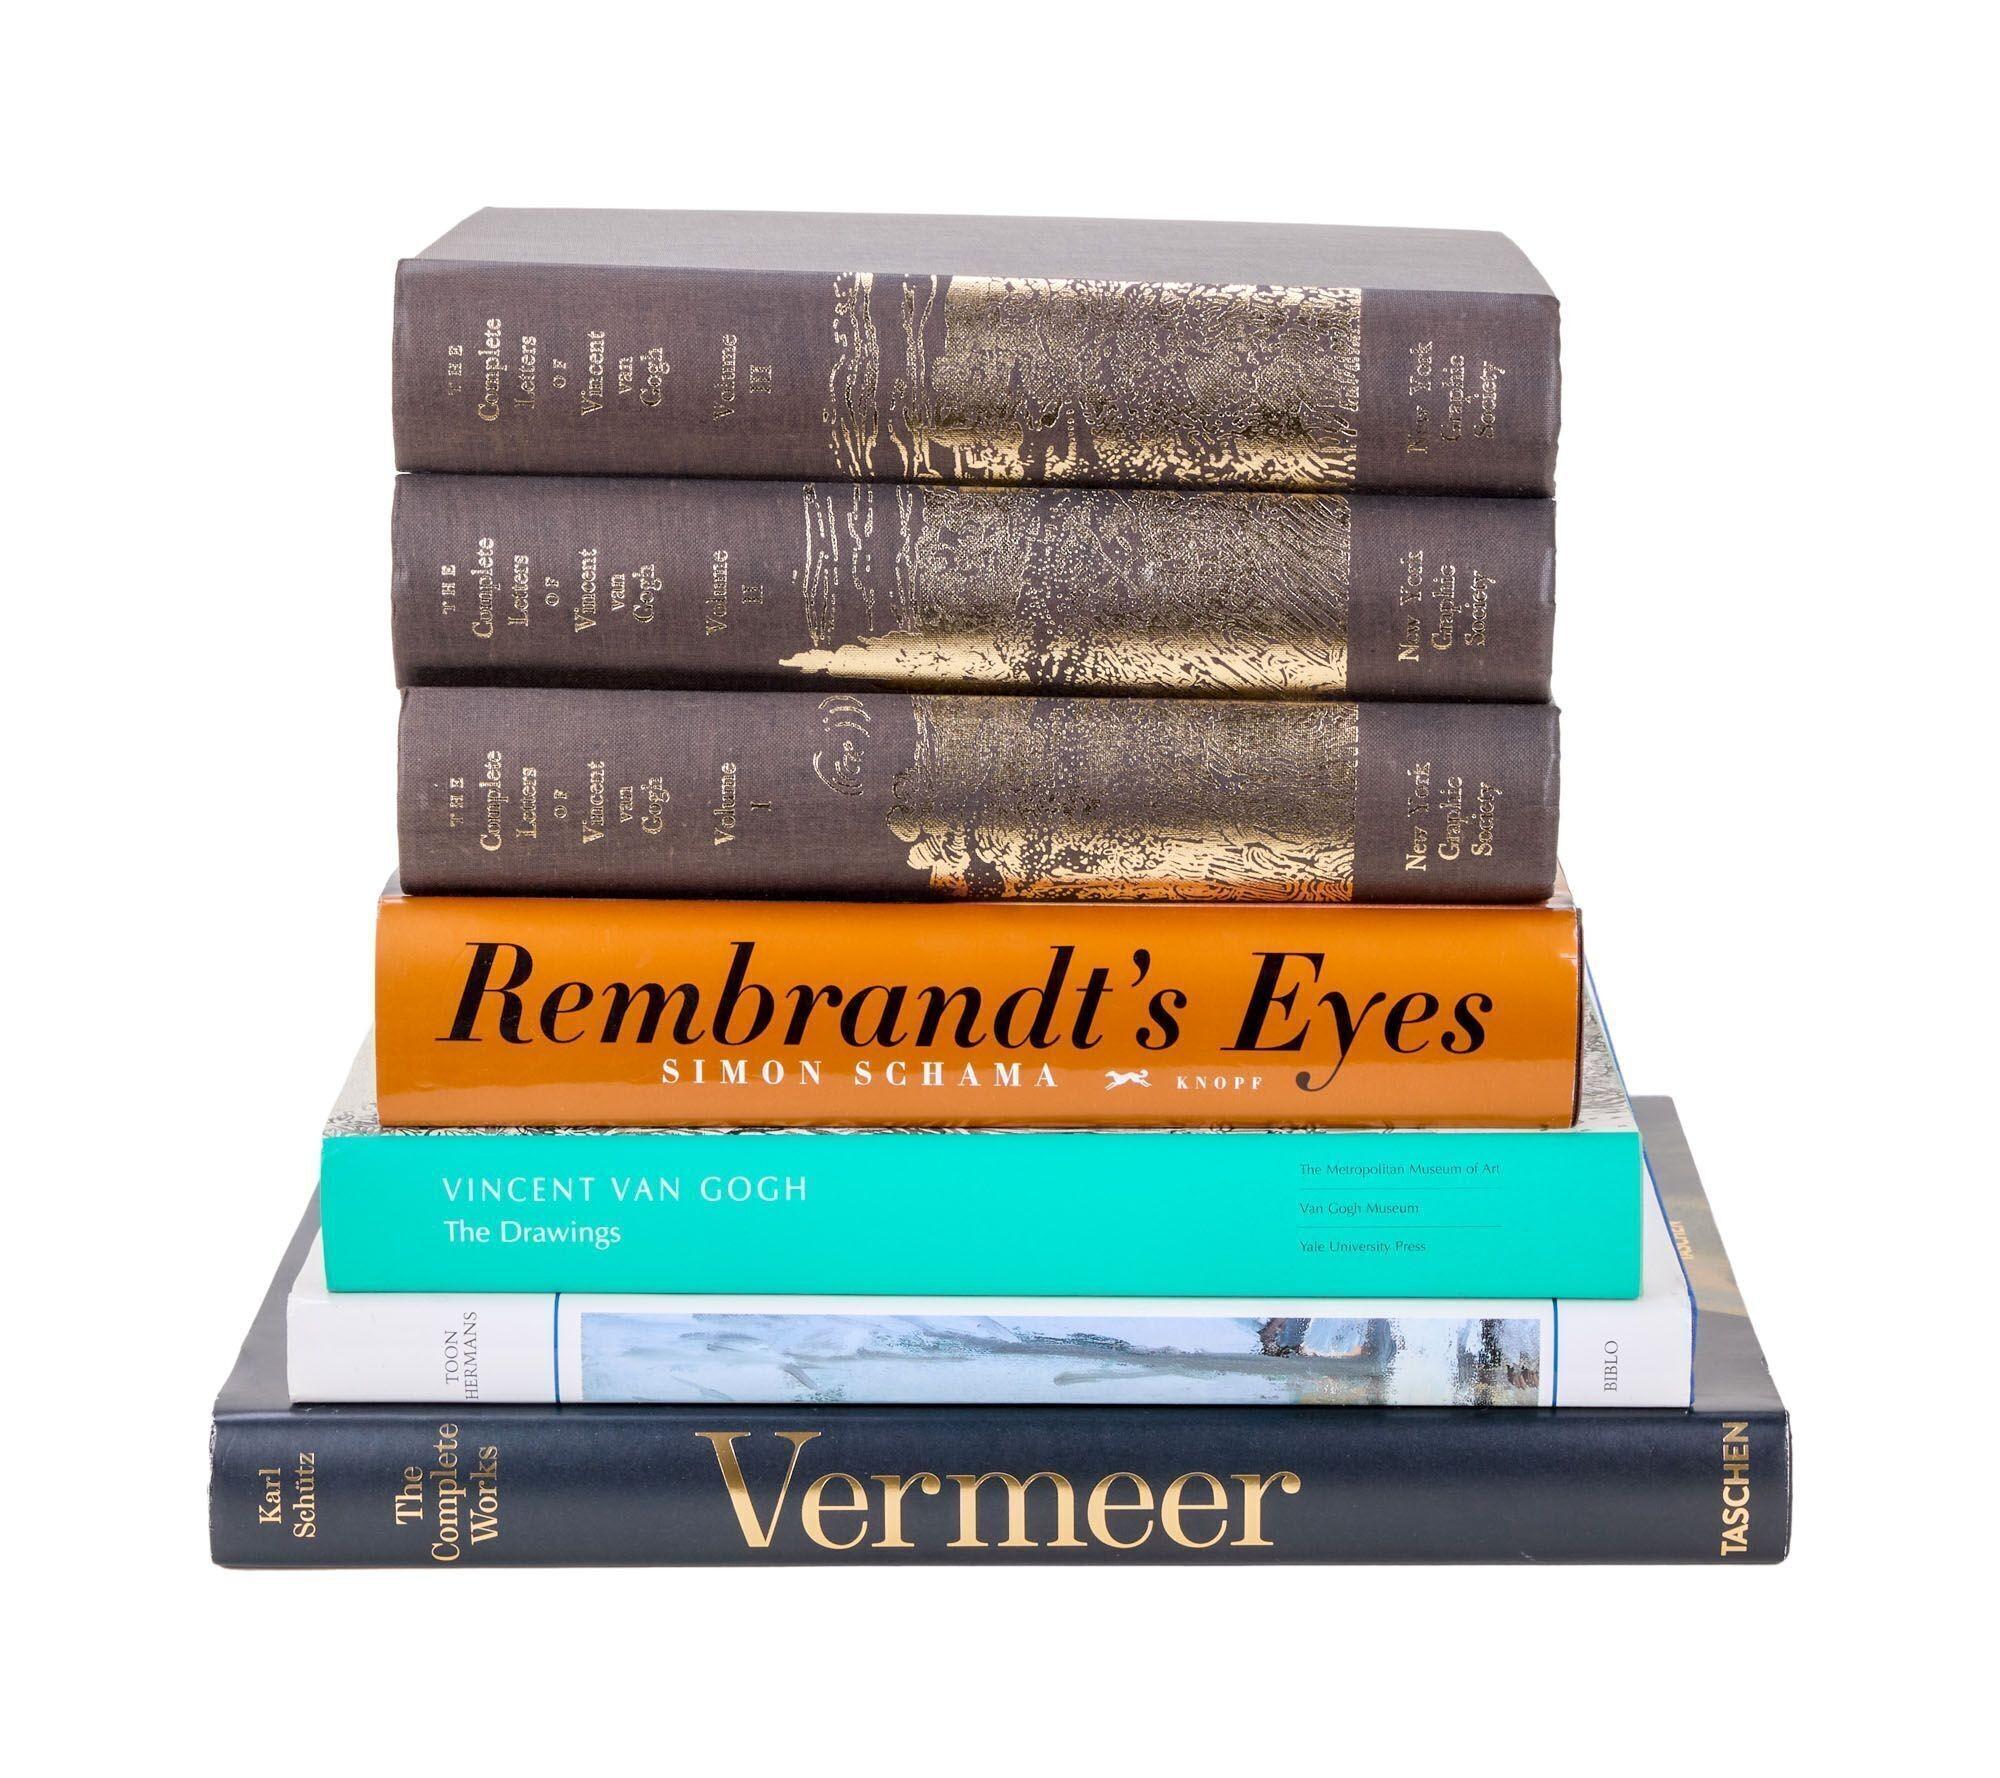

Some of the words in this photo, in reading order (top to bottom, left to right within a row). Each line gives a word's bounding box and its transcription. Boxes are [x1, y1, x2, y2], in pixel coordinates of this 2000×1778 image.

[448, 344, 463, 396] THE
[478, 318, 507, 421] Complete
[514, 335, 537, 409] Letters
[552, 359, 567, 389] OF
[581, 330, 606, 416] Vincent
[618, 356, 633, 394] van
[640, 346, 670, 407] Gogh
[713, 334, 737, 421] Volume
[1409, 341, 1432, 396] York
[1440, 355, 1471, 441] Graphic
[1473, 360, 1506, 438] Society
[1406, 405, 1429, 454] New
[442, 564, 456, 614] THE
[472, 537, 500, 639] Complete
[508, 554, 529, 627] Letters
[545, 577, 559, 606] OF
[574, 548, 597, 632] Vincent
[611, 573, 625, 611] van
[632, 563, 662, 623] Gogh
[706, 549, 728, 636] Volume
[1400, 550, 1423, 606] York
[1432, 565, 1462, 650] Graphic
[1464, 569, 1496, 646] Society
[1398, 615, 1420, 662] New
[450, 777, 464, 827] THE
[479, 750, 508, 851] Complete
[515, 766, 537, 839] Letters
[554, 789, 568, 819] OF
[583, 760, 606, 844] Vincent
[619, 786, 633, 823] van
[641, 776, 670, 835] Gogh
[715, 762, 737, 846] Volume
[1407, 762, 1430, 818] York
[1438, 776, 1468, 861] Graphic
[1471, 781, 1503, 856] Society
[1405, 825, 1427, 872] New
[1220, 951, 1493, 1092] Eyes
[661, 1058, 823, 1085] SIMON
[854, 1060, 1058, 1088] SCHAMA
[1176, 1075, 1264, 1090] KNOPF
[442, 1176, 596, 1202] VINCENT
[611, 1176, 681, 1201] VAN
[700, 1175, 807, 1202] GOGH
[1299, 1163, 1322, 1175] The
[1326, 1163, 1405, 1179] Metropolitan
[1409, 1164, 1462, 1175] Museum
[1466, 1163, 1479, 1175] of
[1481, 1163, 1501, 1175] Art
[443, 1220, 490, 1244] The
[501, 1219, 622, 1251] Drawings
[1299, 1202, 1324, 1215] Van
[1328, 1202, 1362, 1217] Gogh
[1366, 1202, 1419, 1215] Museum
[1299, 1241, 1326, 1252] Yale
[1329, 1241, 1391, 1256] University
[1395, 1241, 1427, 1252] Press
[444, 1330, 459, 1384] TOON
[463, 1311, 479, 1400] HERMANS
[1604, 1339, 1619, 1392] BIBLO
[258, 1467, 282, 1525] Karl
[293, 1452, 316, 1539] Schütz
[395, 1465, 424, 1525] The
[430, 1423, 467, 1562] Complete
[470, 1445, 499, 1546] Works
[695, 1431, 1301, 1550] Vermeer
[1720, 1421, 1749, 1557] TASCHEN
